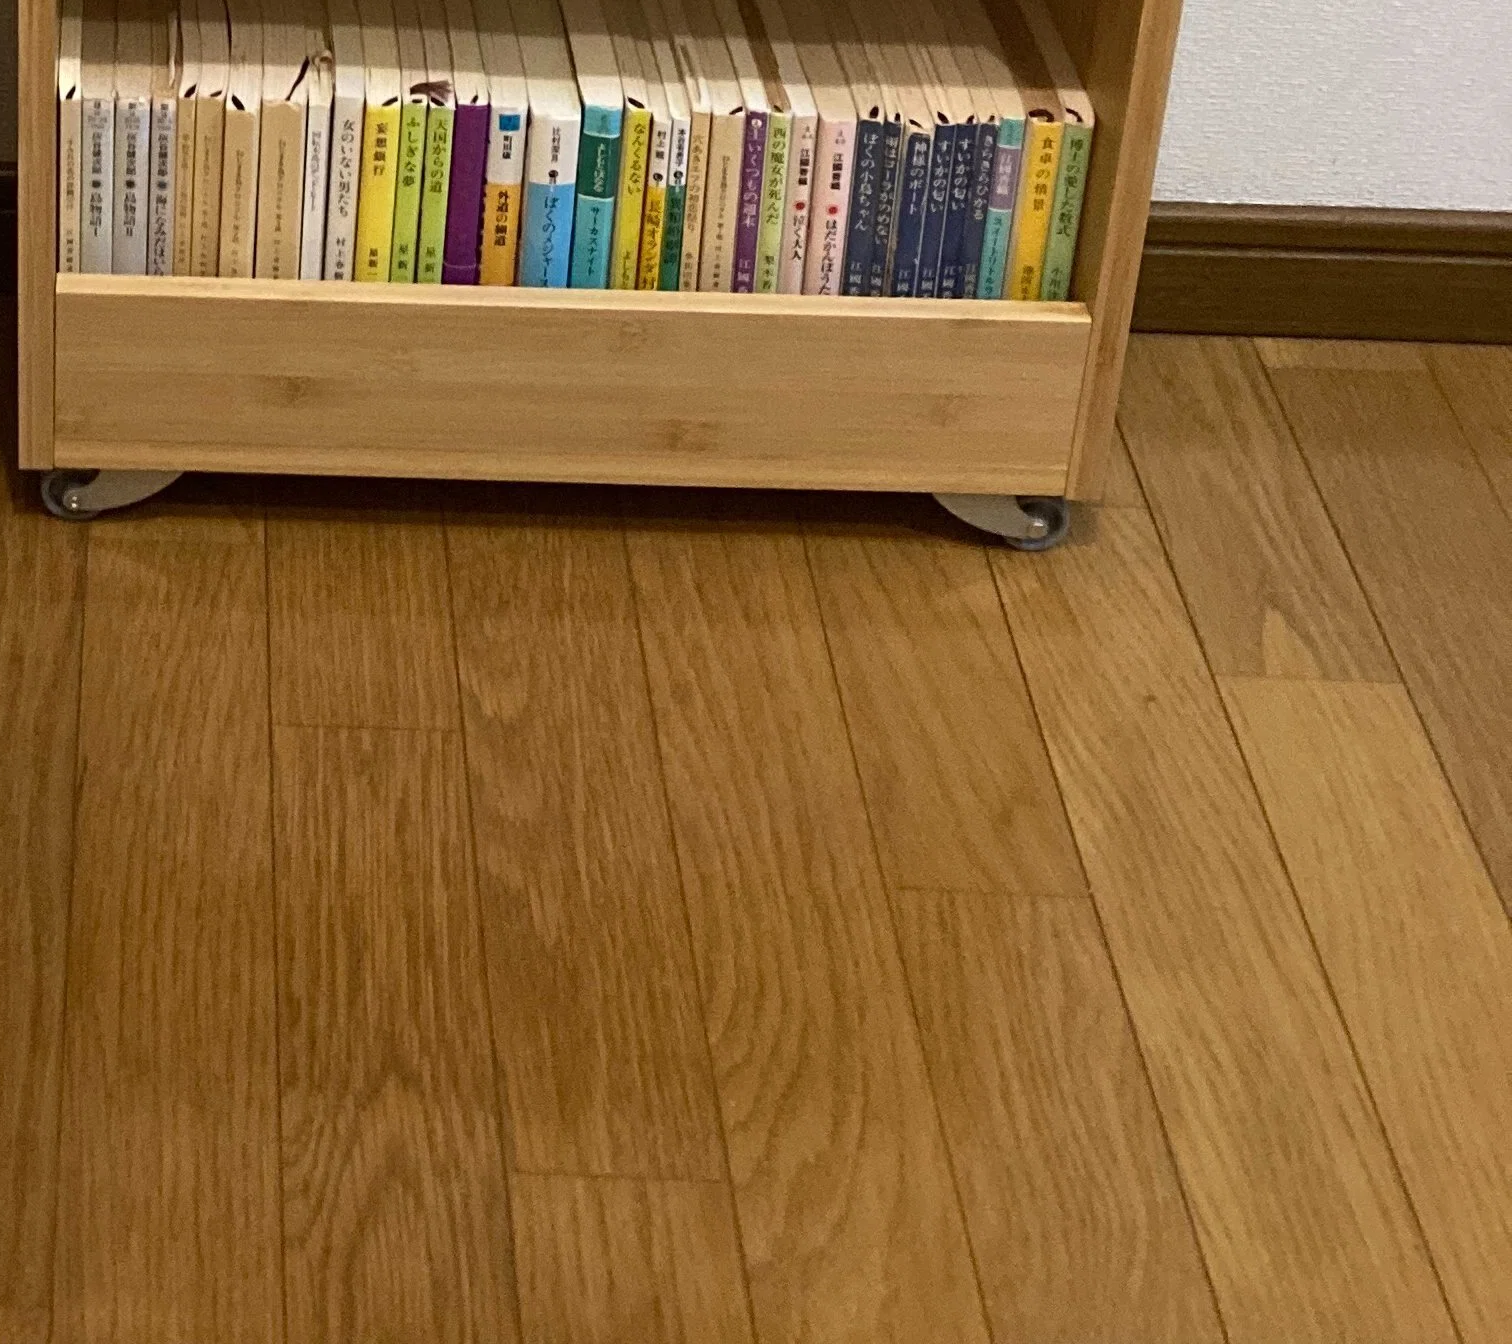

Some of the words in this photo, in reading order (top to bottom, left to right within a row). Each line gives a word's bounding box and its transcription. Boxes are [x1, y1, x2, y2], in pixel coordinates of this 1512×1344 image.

[337, 118, 356, 218] 女のいない男たち
[401, 116, 421, 188] ふしぎな夢
[428, 117, 448, 194] 天国からの道
[625, 124, 646, 197] なんくるない
[764, 126, 787, 225] 西の魔女が死んだ
[853, 133, 879, 232] ぼくの小鳥ちゃん
[907, 141, 928, 215] 神様のボート
[929, 140, 951, 213] すいかの匂い
[949, 137, 970, 212] すいかの匂い
[971, 135, 993, 221] きらきらひかる
[1030, 136, 1055, 213] 食卓の情景
[584, 205, 602, 277] サーカスナイト
